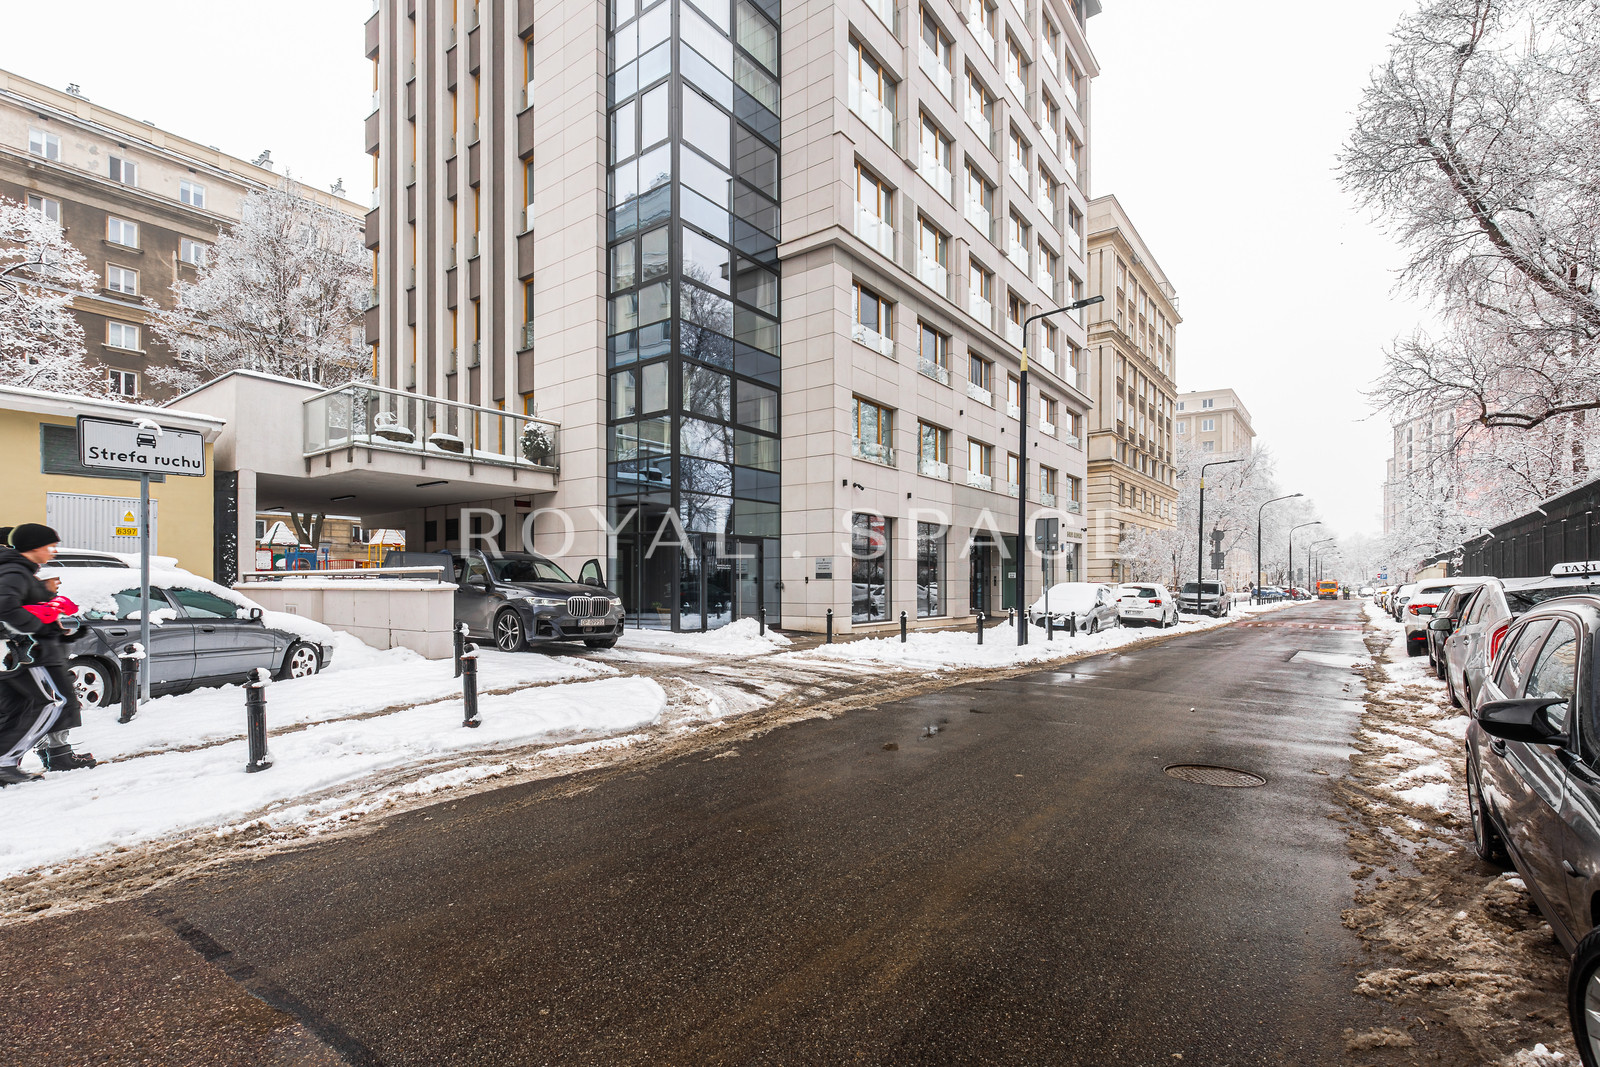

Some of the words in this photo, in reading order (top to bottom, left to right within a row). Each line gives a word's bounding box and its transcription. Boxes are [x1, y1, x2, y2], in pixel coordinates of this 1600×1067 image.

[89, 446, 147, 464] Strefa
[155, 455, 201, 468] ruchu
[1562, 563, 1597, 573] TAXI
